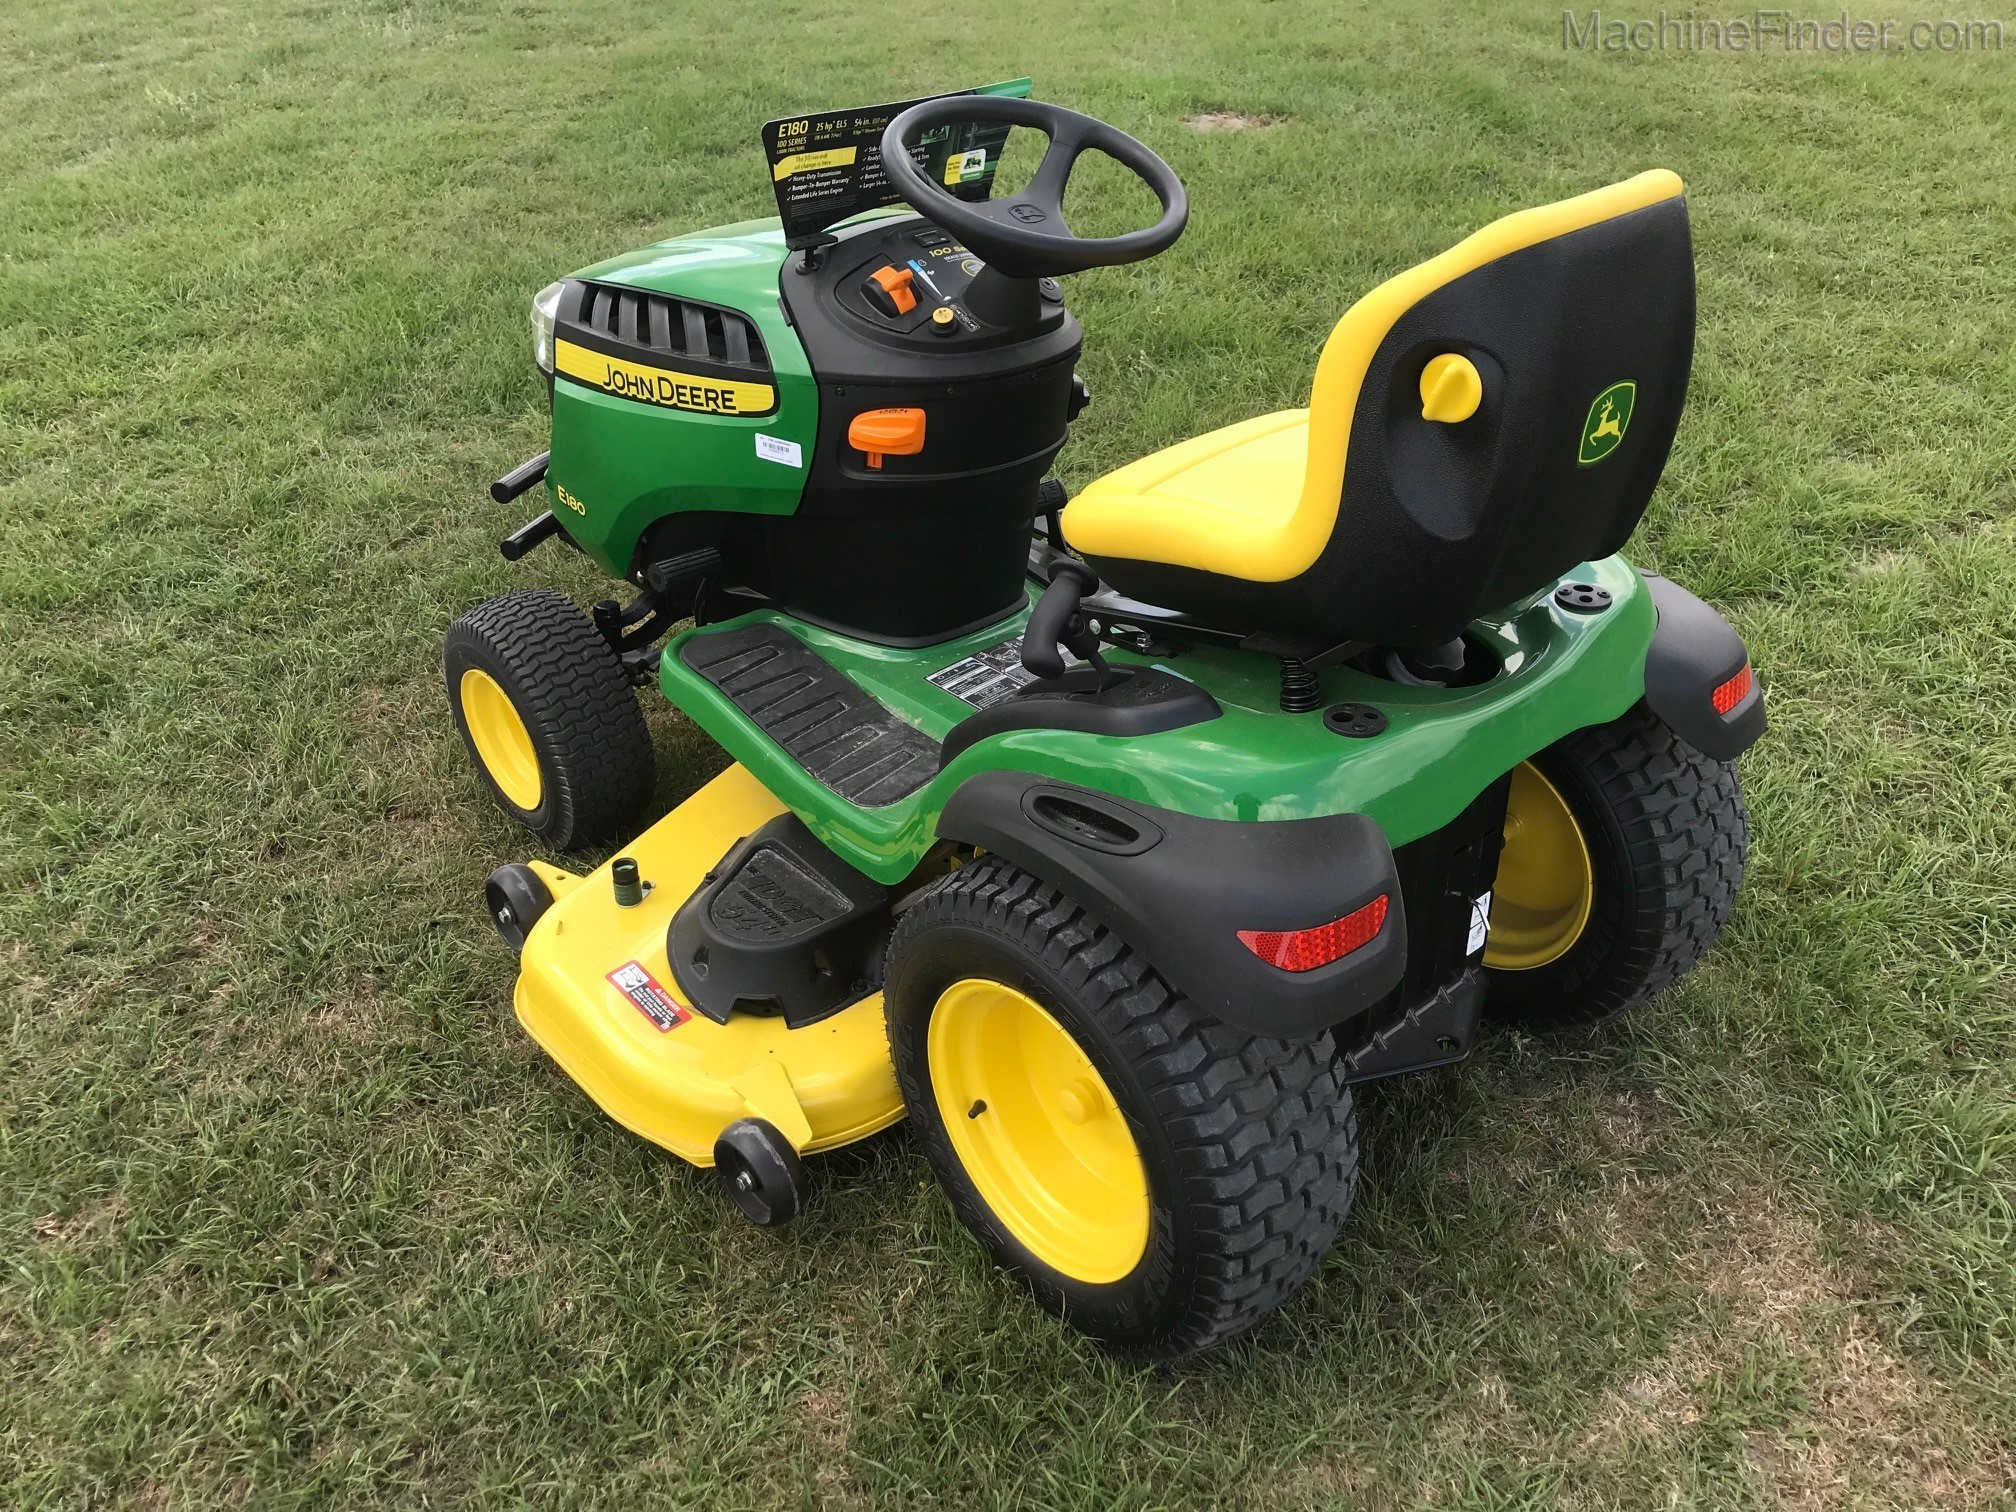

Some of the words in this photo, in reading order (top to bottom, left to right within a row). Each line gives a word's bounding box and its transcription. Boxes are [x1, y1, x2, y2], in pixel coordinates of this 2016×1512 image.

[778, 120, 809, 138] E180
[815, 122, 824, 131] 25
[836, 119, 848, 129] ELS
[854, 118, 862, 127] 54
[777, 140, 787, 148] 100
[788, 137, 807, 147] SERIES
[801, 161, 816, 169] change
[792, 173, 816, 182] Heavy-Duty
[817, 170, 842, 178] Transmission
[791, 192, 809, 201] Extended
[830, 187, 843, 195] Engine
[928, 246, 952, 258] 100
[602, 363, 655, 400] JOHN
[657, 376, 738, 411] DEERE
[557, 484, 587, 516] E180
[660, 991, 682, 1012] DANGER
